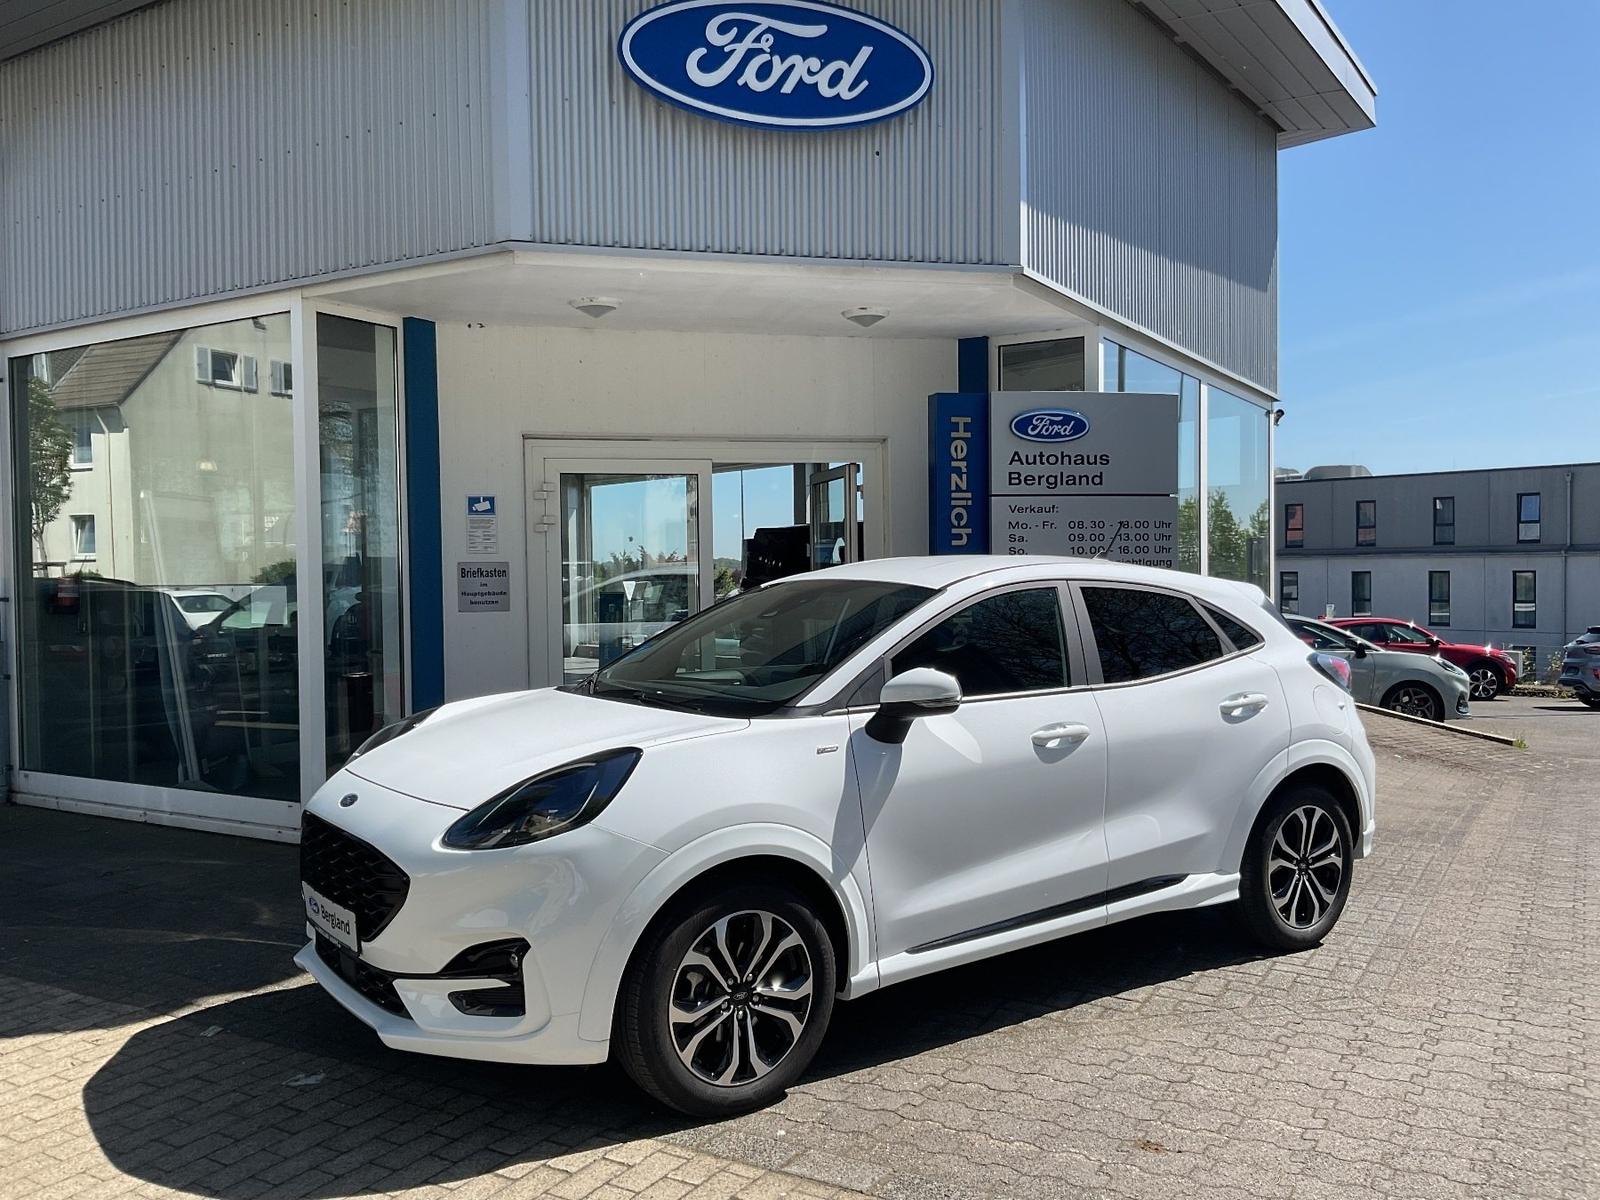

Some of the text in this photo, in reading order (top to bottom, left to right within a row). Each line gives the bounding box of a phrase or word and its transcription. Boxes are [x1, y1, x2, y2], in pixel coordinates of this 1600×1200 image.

[686, 12, 874, 100] Ford
[1027, 415, 1075, 436] Ford
[1008, 451, 1110, 466] Autohaus
[950, 416, 972, 546] Herzlich
[1008, 472, 1104, 490] Bergland
[1008, 504, 1060, 514] Verkauf:
[1008, 521, 1032, 530] Mo.
[1042, 520, 1057, 530] Fr.
[1068, 520, 1106, 530] 08.30
[1154, 520, 1173, 529] Uhr
[1008, 533, 1029, 543] Sa.
[1068, 533, 1106, 542] 09.00
[1118, 533, 1150, 542] 13.00
[1154, 533, 1173, 542] Uhr
[1008, 546, 1029, 556] So.
[1071, 546, 1106, 555] 10.00
[1118, 546, 1150, 555] 16.00
[1154, 546, 1173, 554] Uhr
[1115, 558, 1173, 568] ihtigung
[460, 568, 507, 578] Briefkasten
[320, 904, 350, 935] Bergland
